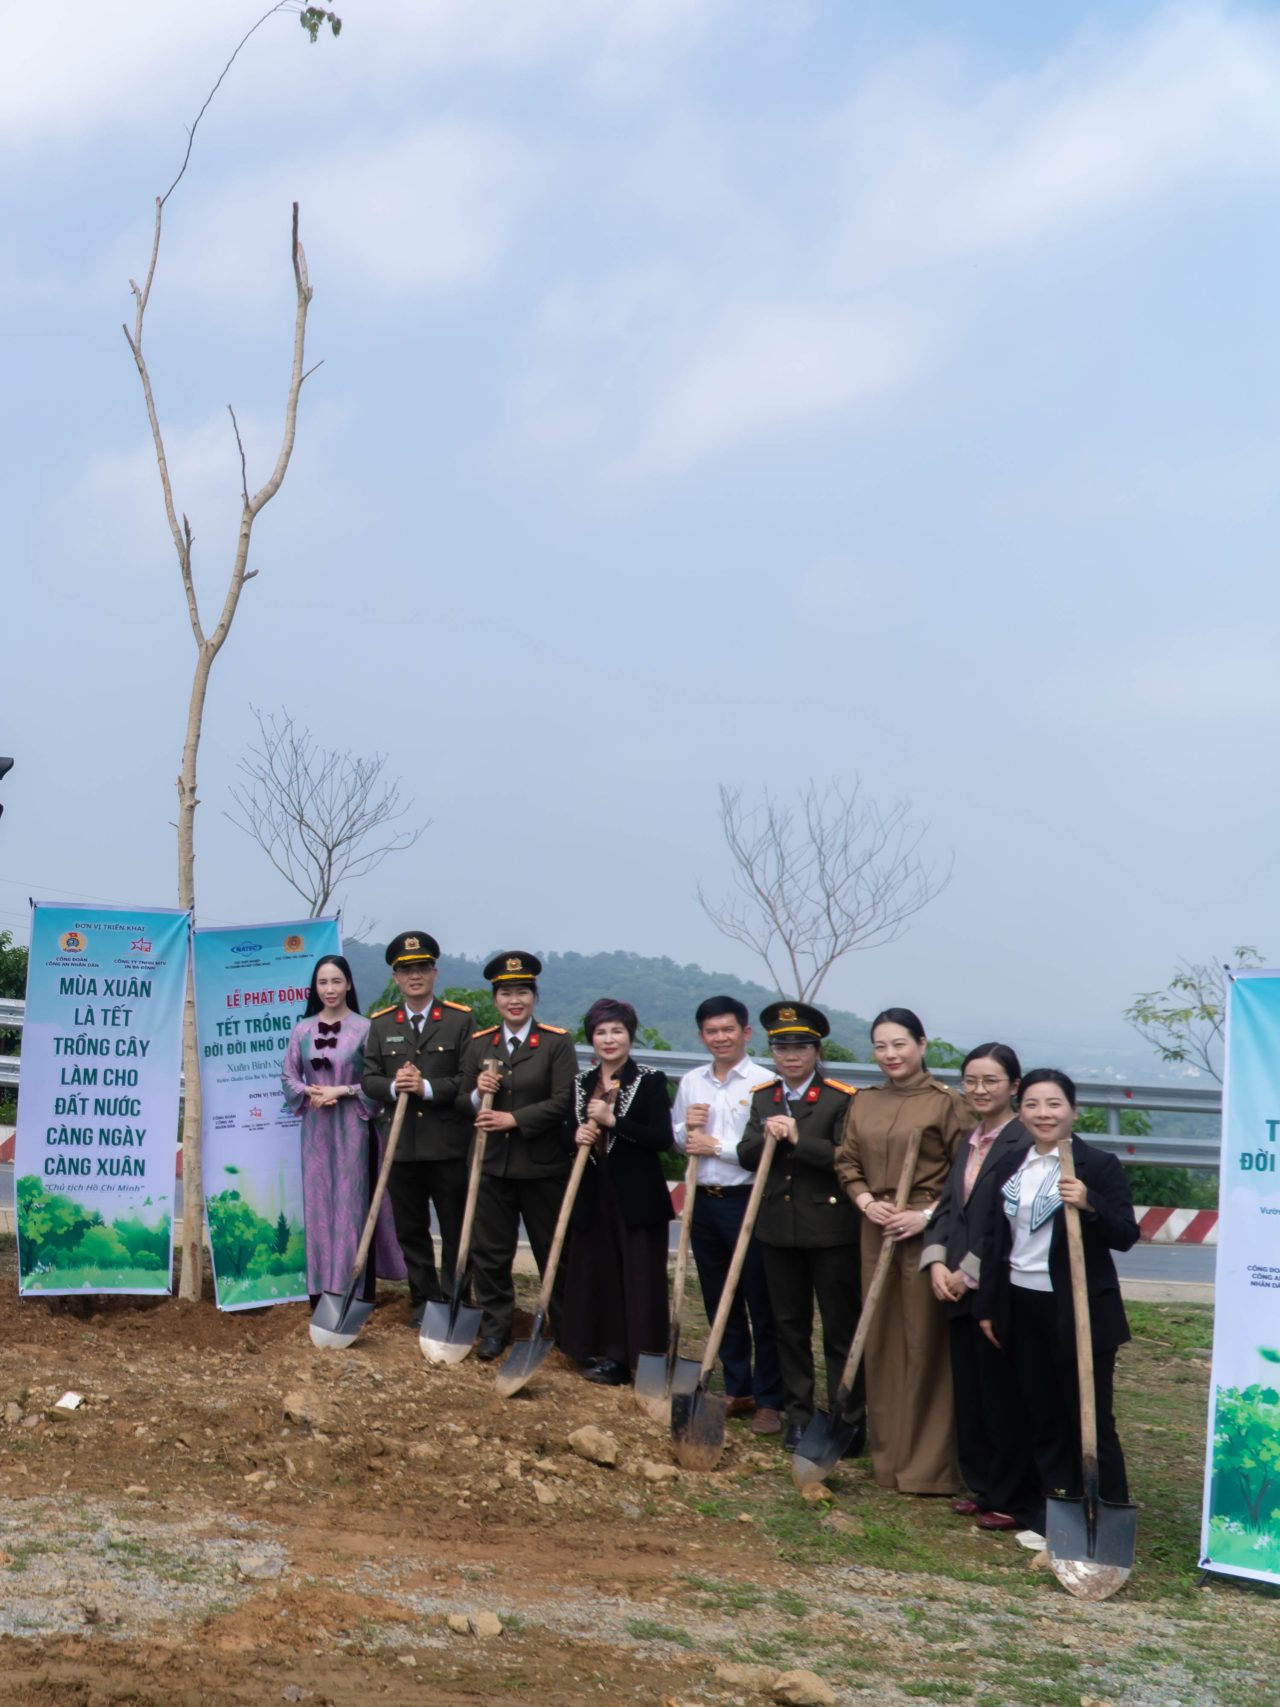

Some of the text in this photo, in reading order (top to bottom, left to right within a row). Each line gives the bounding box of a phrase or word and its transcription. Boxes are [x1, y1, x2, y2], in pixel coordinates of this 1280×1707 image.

[94, 923, 102, 931] VỊ
[103, 922, 125, 931] TRIỂN
[60, 974, 152, 998] MÙA XUÂN
[226, 989, 240, 1008] LỄ
[74, 1003, 133, 1027] LÀ TẾT
[215, 1015, 240, 1037] TẾT
[244, 1012, 292, 1034] TRỒNG
[53, 1032, 151, 1057] TRỒNG CÂY
[204, 1041, 223, 1058] ĐỜI
[227, 1039, 246, 1055] ĐỜI
[250, 1036, 274, 1053] NHỚ
[61, 1063, 138, 1087] LÀM CHO
[227, 1063, 250, 1073] Xuân
[54, 1092, 142, 1117] ĐẤT NƯỚC
[46, 1124, 147, 1147] CÀNG NGÀY
[44, 1153, 146, 1177] CÀNG XUÂN
[1239, 1148, 1276, 1172] ĐỜI
[67, 1184, 83, 1193] tịch
[86, 1183, 98, 1192] Hồ
[1252, 1272, 1273, 1280] CÔNG
